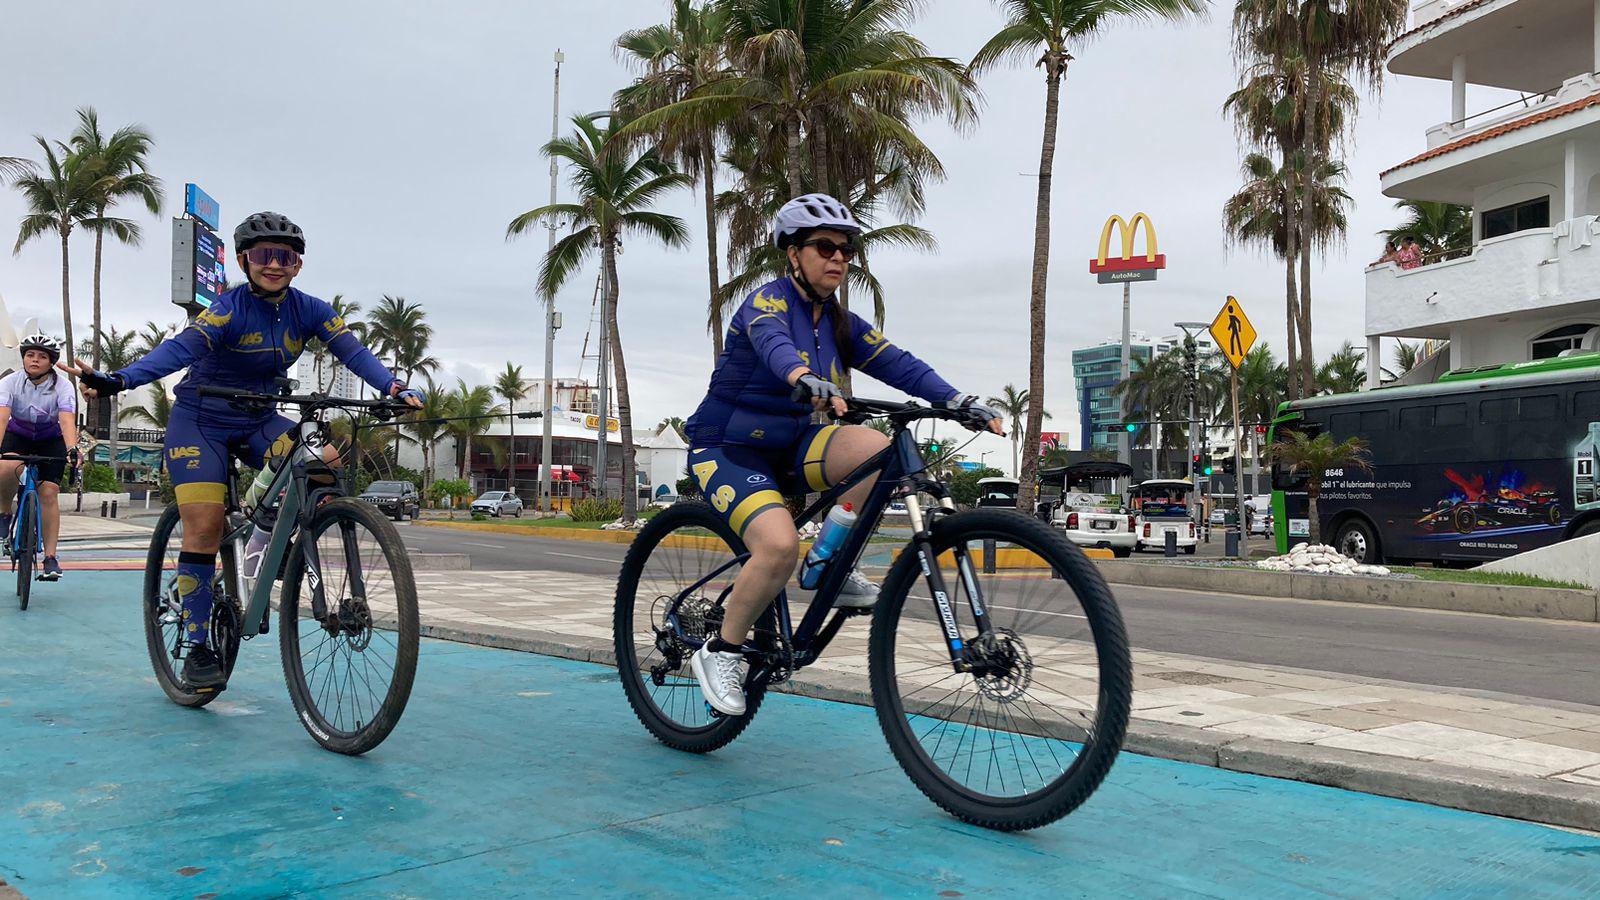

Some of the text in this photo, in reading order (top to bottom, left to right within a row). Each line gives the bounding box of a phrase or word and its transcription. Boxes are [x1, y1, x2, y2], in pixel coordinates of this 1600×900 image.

[1111, 271, 1141, 280] AutoMac
[239, 331, 263, 346] UAS
[169, 446, 200, 460] UAS
[1325, 468, 1344, 477] 8646
[1321, 481, 1331, 489] obil
[1340, 480, 1346, 489] el
[1346, 480, 1375, 489] lubricante
[1376, 482, 1387, 490] que
[1388, 480, 1411, 490] impulsa
[1329, 492, 1347, 501] pilotos
[1347, 491, 1373, 500] favoritos.
[1497, 507, 1528, 515] ORACLE
